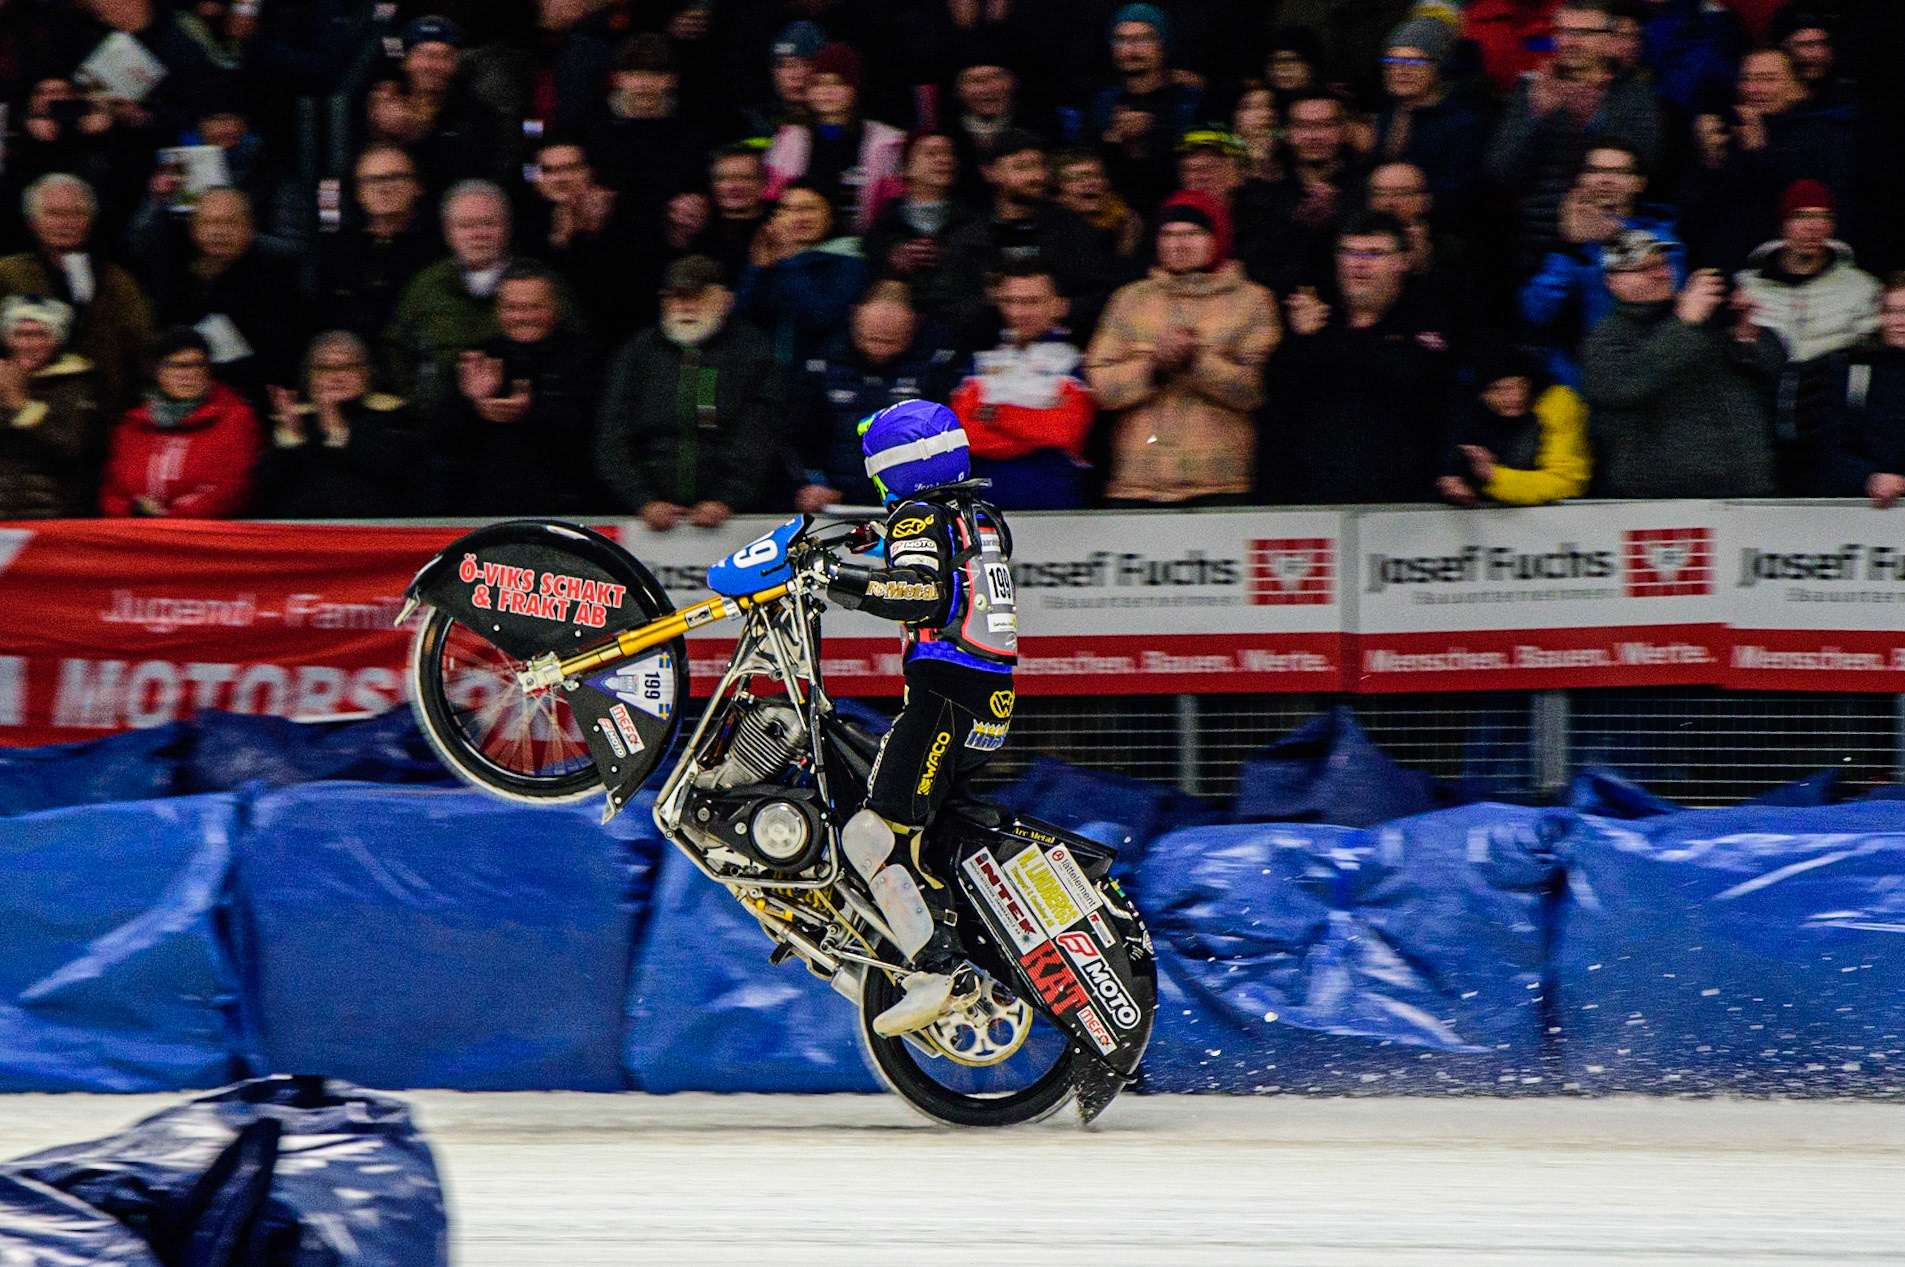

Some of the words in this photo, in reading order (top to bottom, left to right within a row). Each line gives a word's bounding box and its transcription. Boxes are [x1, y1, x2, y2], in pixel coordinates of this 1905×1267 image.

[460, 553, 535, 592] Ö-VIKS
[540, 573, 626, 608] SCHAKT
[1014, 550, 1107, 588] osef
[1116, 549, 1242, 587] Fuchs
[1366, 546, 1482, 592] Josef
[1485, 542, 1617, 583] Fuchs
[1737, 543, 1861, 588] Josef
[472, 584, 492, 609] &
[498, 589, 570, 622] FRAKT
[573, 603, 607, 628] AB
[644, 671, 661, 700] 199
[607, 730, 626, 757] MOTO
[1029, 829, 1056, 845] Metal
[1024, 859, 1079, 927] LINDBERGS
[1060, 857, 1097, 908] lättelement
[1020, 940, 1089, 1016] KAT
[1086, 964, 1138, 1024] MOTO
